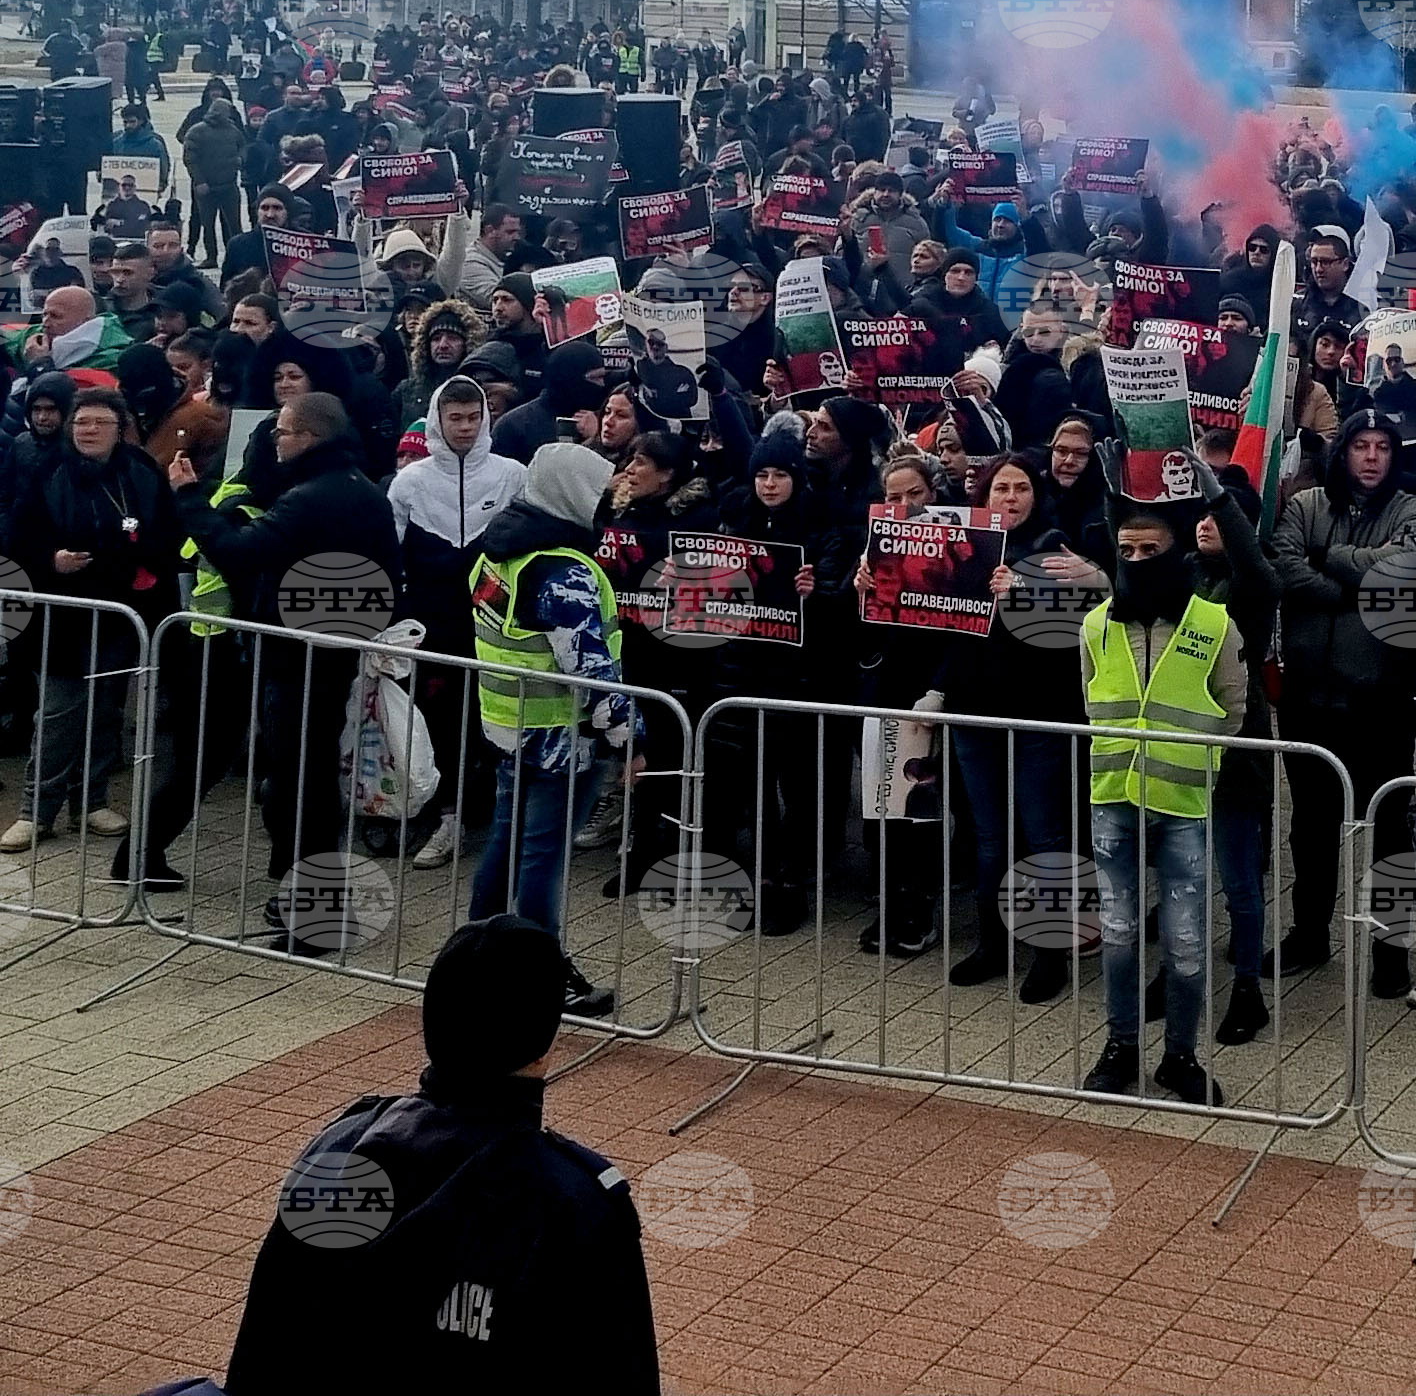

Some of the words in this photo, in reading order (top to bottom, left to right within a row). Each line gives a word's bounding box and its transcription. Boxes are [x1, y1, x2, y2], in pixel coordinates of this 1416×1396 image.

[1077, 140, 1113, 150] СВОБОДА
[1114, 141, 1128, 150] ЗА
[1079, 148, 1115, 158] СИМО!
[364, 157, 417, 168] СВОБОДА
[419, 154, 433, 165] ЗА
[952, 161, 985, 170] СИМО!
[983, 153, 996, 161] ЗА
[371, 166, 418, 178] СИМО!
[771, 173, 811, 186] СВОБОДА
[812, 177, 825, 188] ЗА
[773, 182, 812, 196] СИМО!
[622, 195, 670, 209] СВОБОДА
[673, 192, 687, 203] ЗА
[629, 204, 674, 219] СИМО!
[265, 229, 311, 248] СВОБОДА
[314, 238, 330, 250] ЗА
[271, 243, 313, 260] СИМО!
[1115, 259, 1163, 280] СВОБОДА
[1166, 270, 1185, 283] ЗА
[1116, 274, 1165, 295] СИМО!
[629, 302, 643, 317] ТЕБ
[844, 319, 907, 333] СВОБОДА
[910, 320, 927, 332] ЗА
[1143, 320, 1198, 339] СВОБОДА
[1203, 328, 1223, 344] ЗА
[851, 333, 910, 347] СИМО!
[1144, 335, 1198, 356] СИМО!
[619, 533, 637, 547] ЗА
[873, 521, 943, 542] СВОБОДА
[947, 529, 968, 543] ЗА
[674, 537, 746, 555] СВОБОДА
[750, 544, 768, 557] ЗА
[879, 538, 944, 559] СИМО!
[685, 551, 748, 570] СИМО!
[900, 591, 993, 616] СПРАВЕДЛИВОСТ
[705, 601, 798, 624] СПРАВЕДЛИВОСТ
[671, 615, 697, 632] ЗА
[703, 617, 798, 641] МОМЧИЛ!
